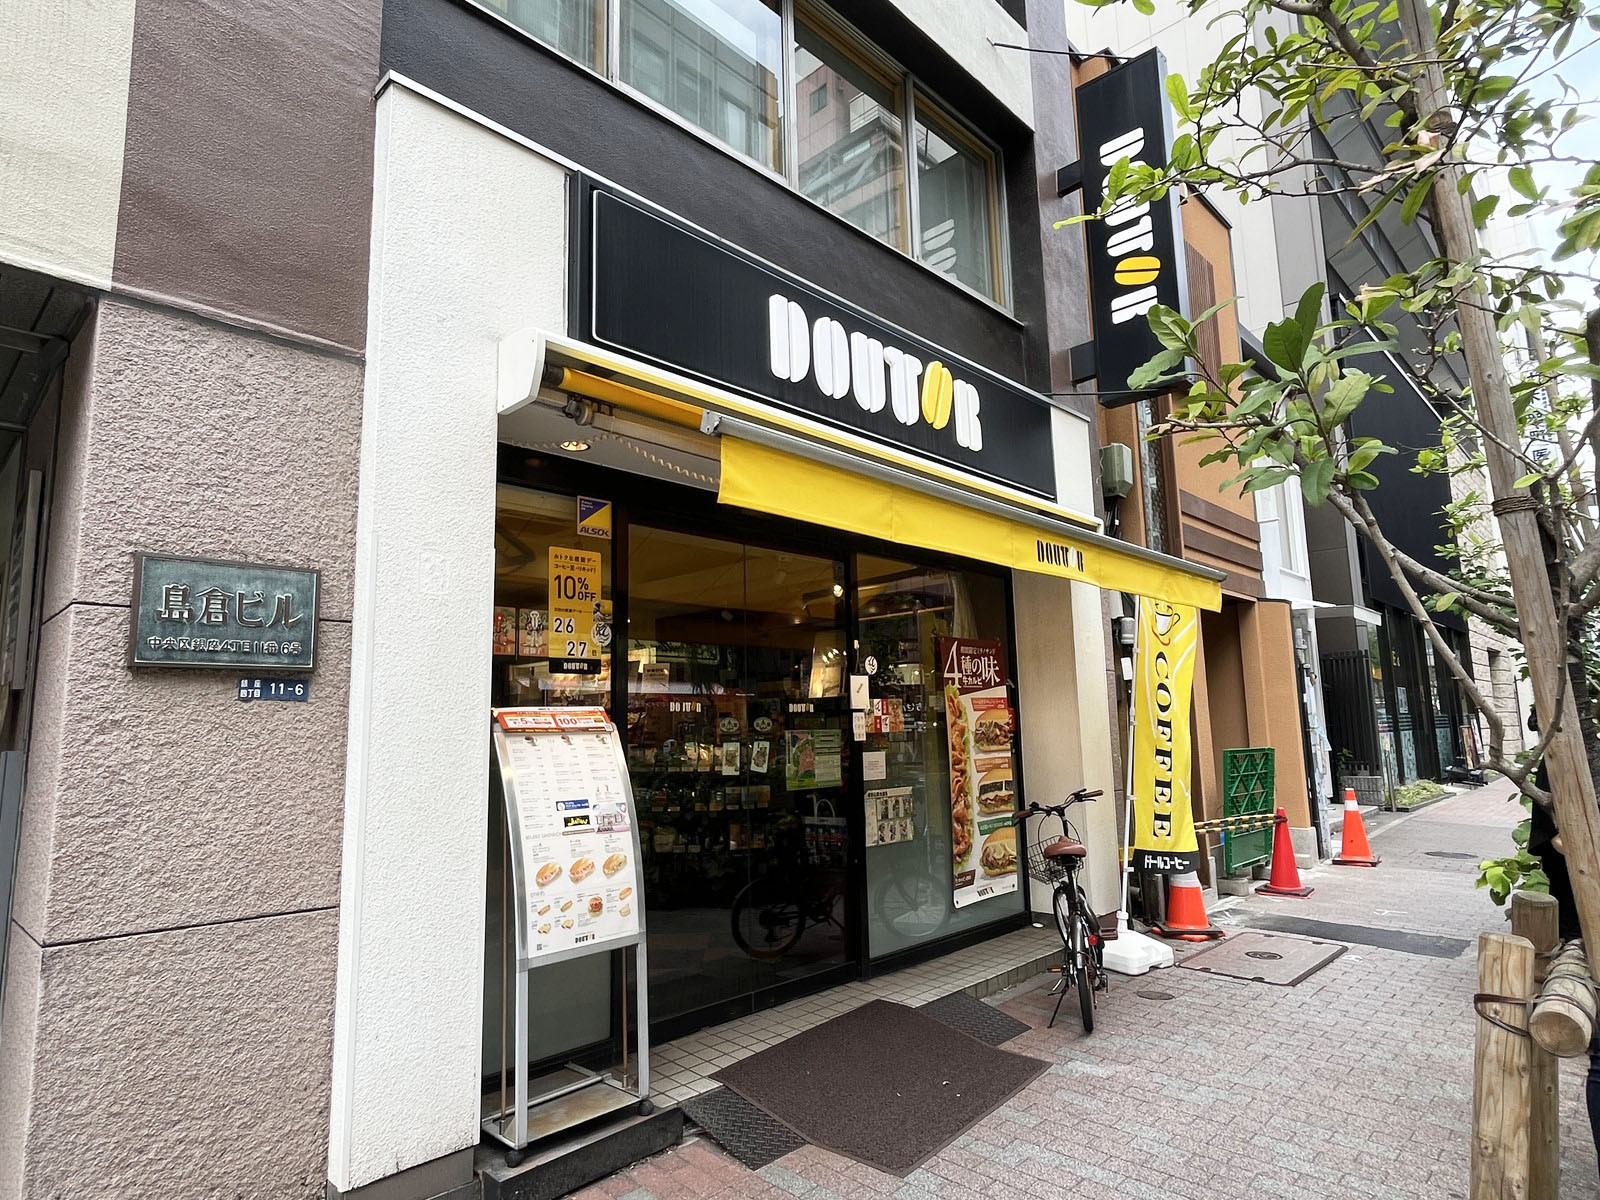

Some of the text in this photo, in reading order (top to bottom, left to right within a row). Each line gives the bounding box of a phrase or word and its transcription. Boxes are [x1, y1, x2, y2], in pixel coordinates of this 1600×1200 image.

[769, 294, 983, 452] DOUTOR
[579, 526, 609, 538] ALSOK
[1036, 539, 1084, 573] DOUTOR
[554, 574, 597, 602] 10% OFF
[156, 584, 304, 629] 島倉ビル
[554, 617, 574, 634] 26
[567, 641, 587, 657] 27
[563, 662, 588, 671] DOUTOR
[270, 682, 304, 696] 11-6
[788, 702, 814, 713] DOUTOR
[1153, 651, 1174, 838] COFFEE
